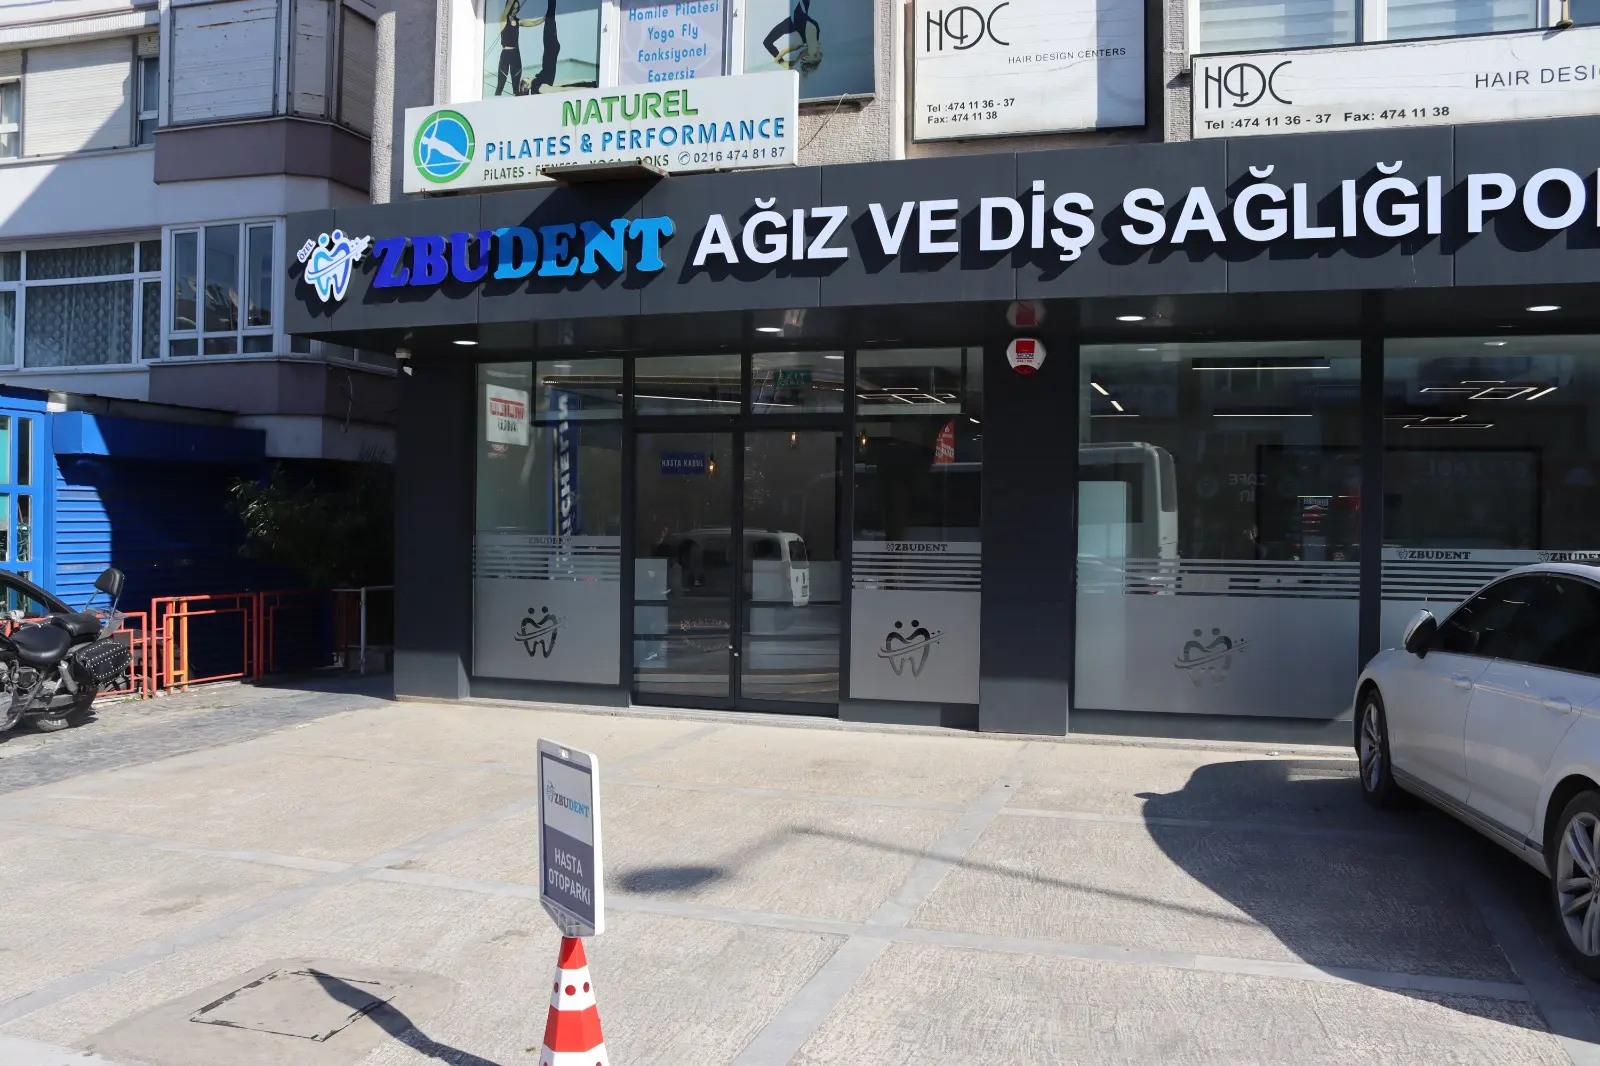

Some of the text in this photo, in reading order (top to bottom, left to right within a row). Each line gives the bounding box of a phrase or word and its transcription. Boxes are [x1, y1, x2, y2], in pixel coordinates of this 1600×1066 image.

[629, 0, 720, 22] Hamile Pilatesi
[648, 23, 699, 43] Yoga Fly
[637, 43, 707, 63] Fonksiyonel
[1008, 47, 1127, 65] HAIR DESIGN CENTERS
[1475, 64, 1600, 88] HAIR DESI
[561, 88, 699, 127] NATUREL
[927, 104, 941, 113] Tel
[969, 100, 979, 109] 11
[982, 99, 994, 108] 36
[1003, 98, 1016, 107] 37
[927, 110, 998, 124] Fax: 474 11 38
[1205, 119, 1225, 130] Tel
[1264, 116, 1279, 127] 11
[1284, 115, 1301, 126] 36
[1315, 113, 1332, 124] 37
[1344, 111, 1375, 122] Fax:
[1380, 109, 1406, 120] 474
[1411, 107, 1426, 118] 11
[1432, 106, 1450, 117] 38
[580, 132, 593, 154] &
[601, 117, 785, 151] PERFORMANCE
[693, 146, 786, 164] 0216 474 81 87
[372, 160, 1600, 288] ZBUDENT AĞIZ VE DİŞ SAĞLIĞI PO
[894, 543, 949, 552] ZBUDENT
[1408, 550, 1472, 560] ZBUDENT
[1550, 552, 1600, 562] ZBUDE
[554, 792, 590, 818] ZBUDENT
[554, 847, 584, 877] HASTA
[548, 867, 591, 906] OTOPARKI
